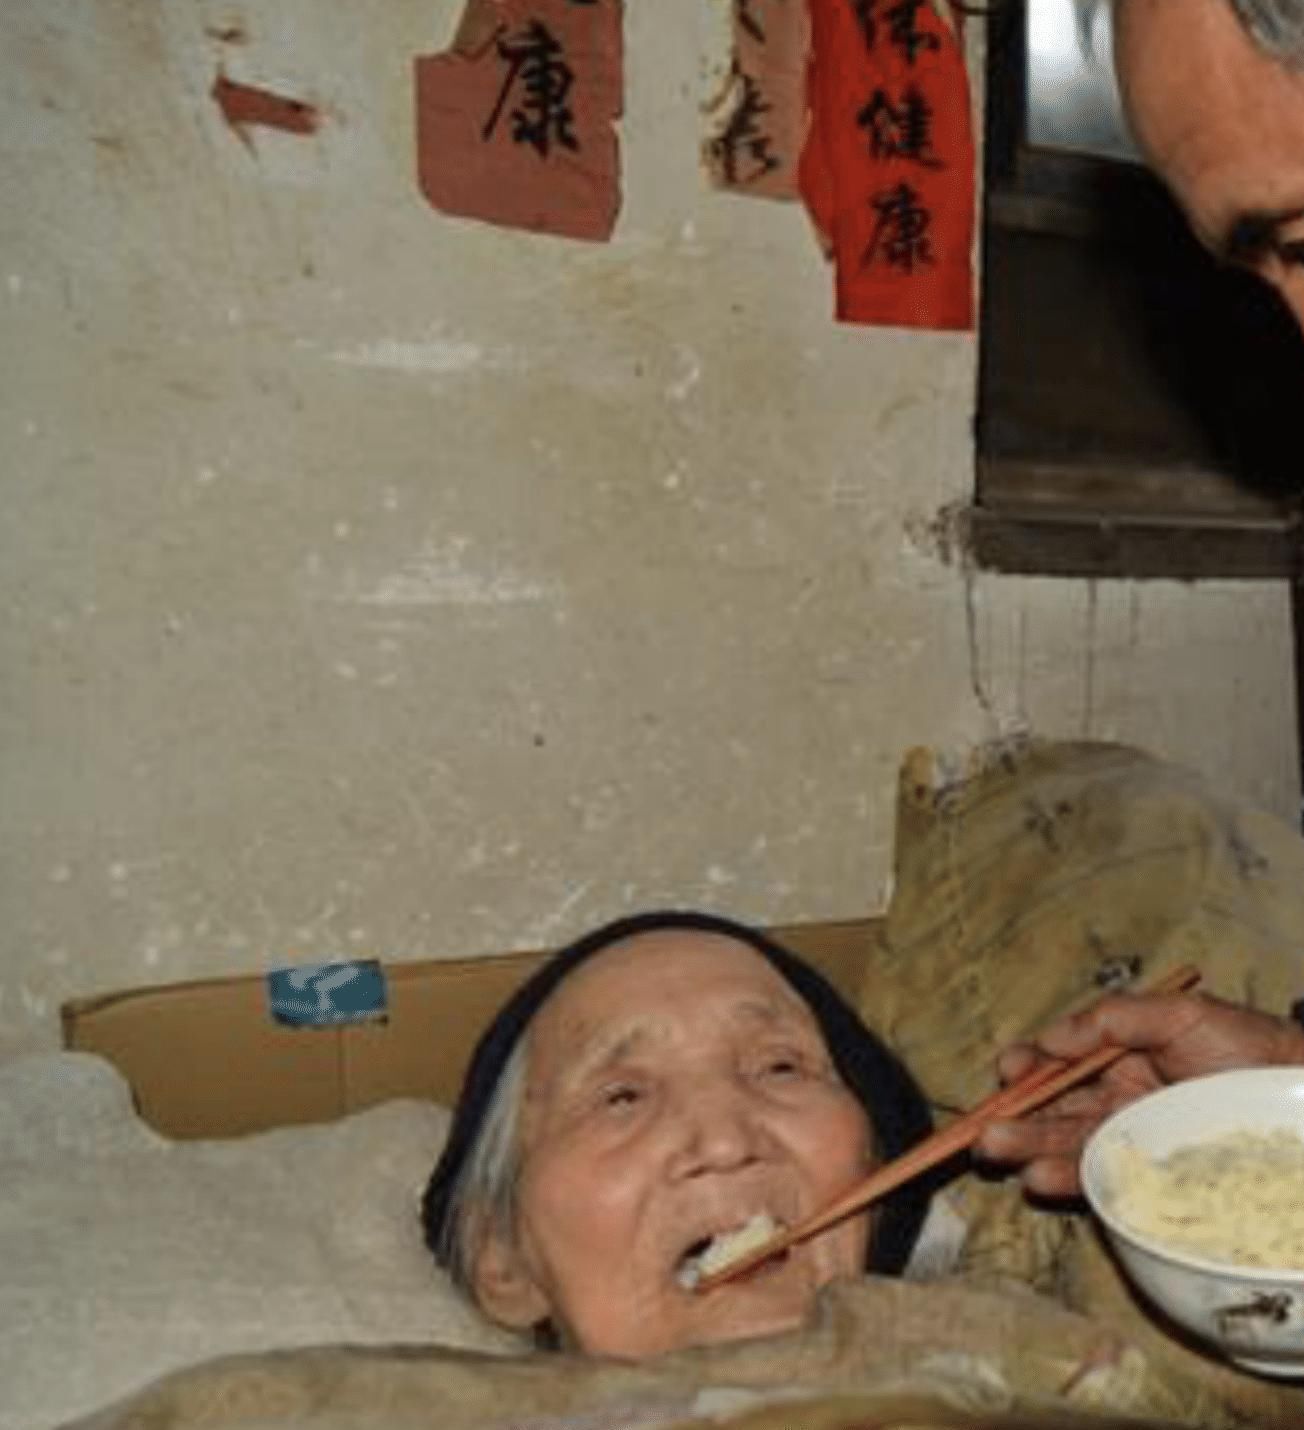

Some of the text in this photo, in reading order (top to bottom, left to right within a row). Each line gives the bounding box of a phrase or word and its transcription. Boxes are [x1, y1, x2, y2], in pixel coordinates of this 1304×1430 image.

[480, 0, 599, 159] 康
[853, 0, 946, 276] 体健康
